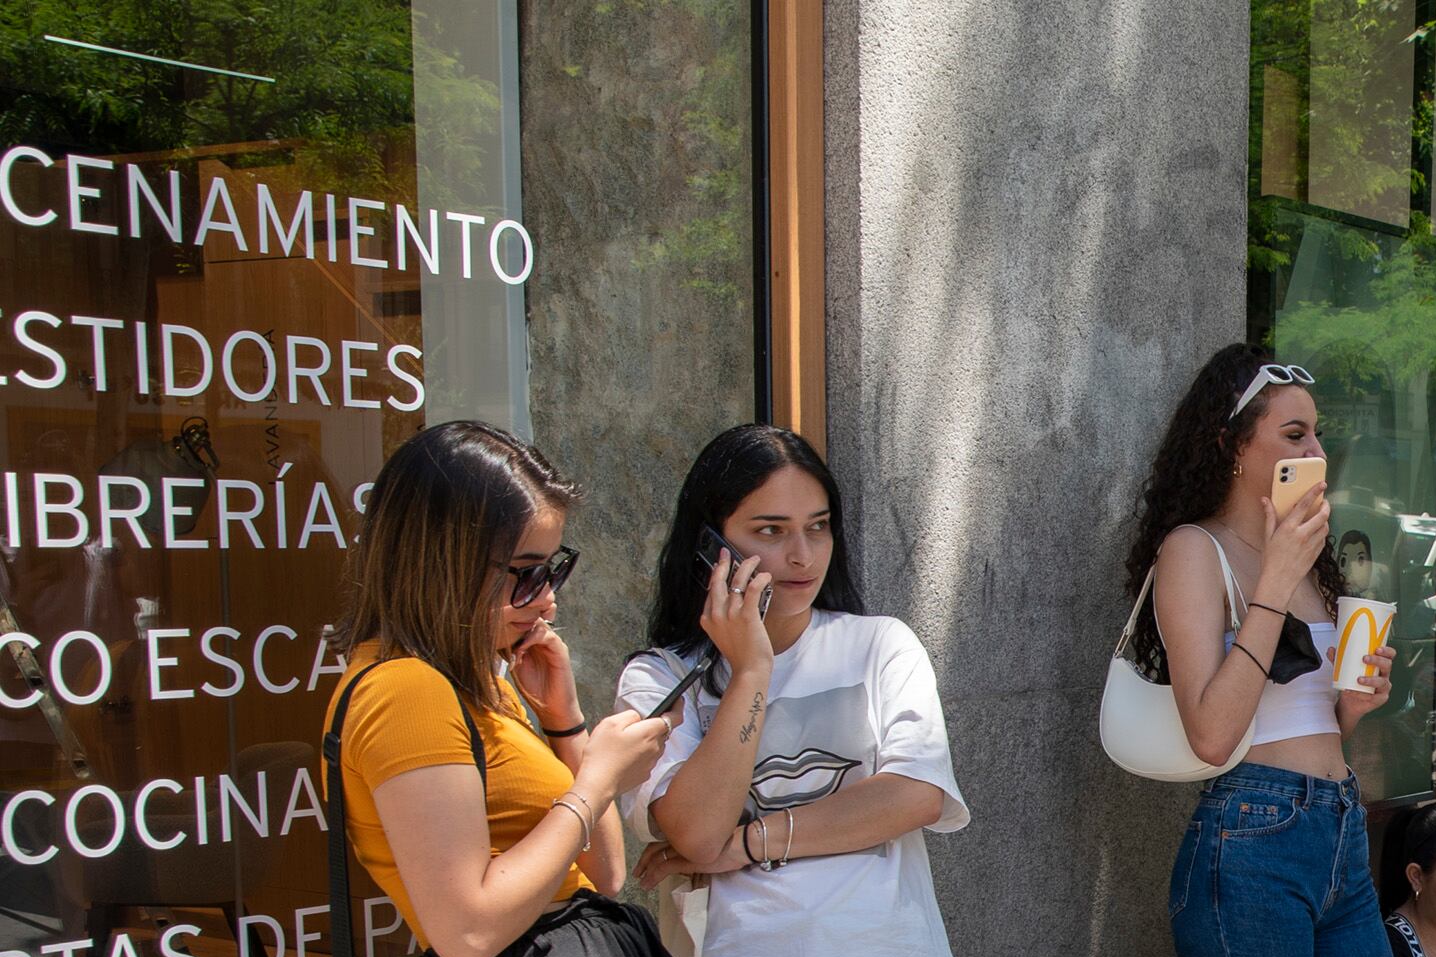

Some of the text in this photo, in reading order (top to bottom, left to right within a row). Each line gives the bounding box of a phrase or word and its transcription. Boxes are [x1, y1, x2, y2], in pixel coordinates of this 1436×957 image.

[0, 146, 533, 285] CENAMIENTO
[0, 630, 112, 708] CO
[2, 767, 329, 865] COCINA
